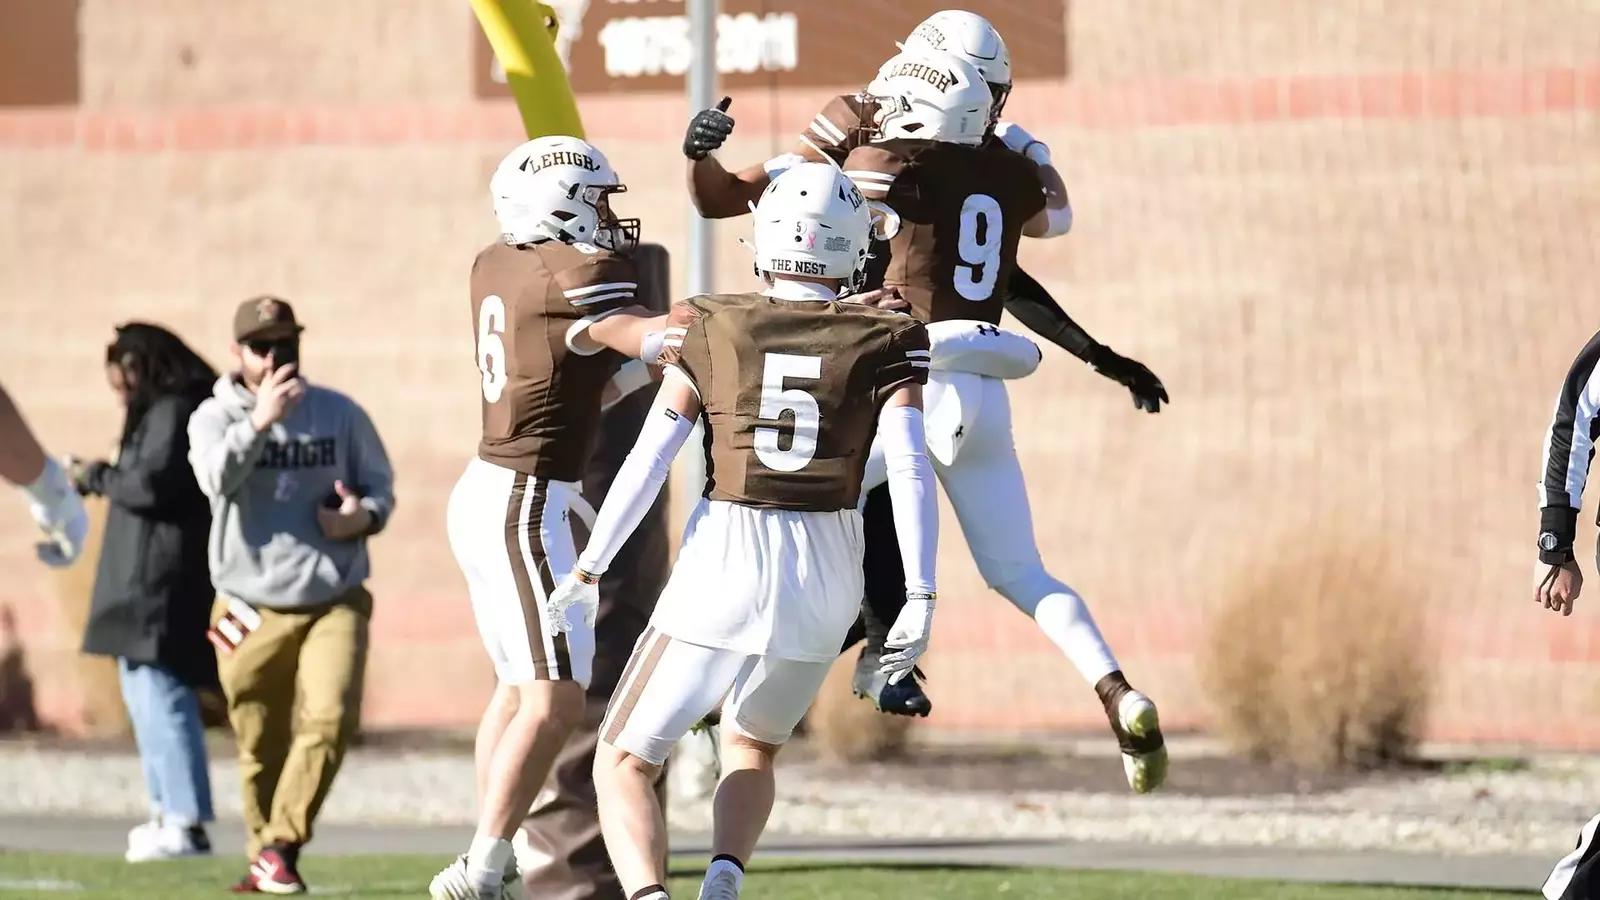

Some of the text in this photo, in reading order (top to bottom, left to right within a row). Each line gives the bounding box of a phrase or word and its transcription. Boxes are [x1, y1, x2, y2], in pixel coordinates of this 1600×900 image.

[889, 62, 951, 93] LEHIGH
[530, 151, 597, 174] LEHIGH
[796, 221, 802, 233] 5
[953, 193, 1003, 302] 9
[771, 259, 827, 276] THE NEST
[477, 294, 508, 404] 6
[753, 352, 823, 472] 5
